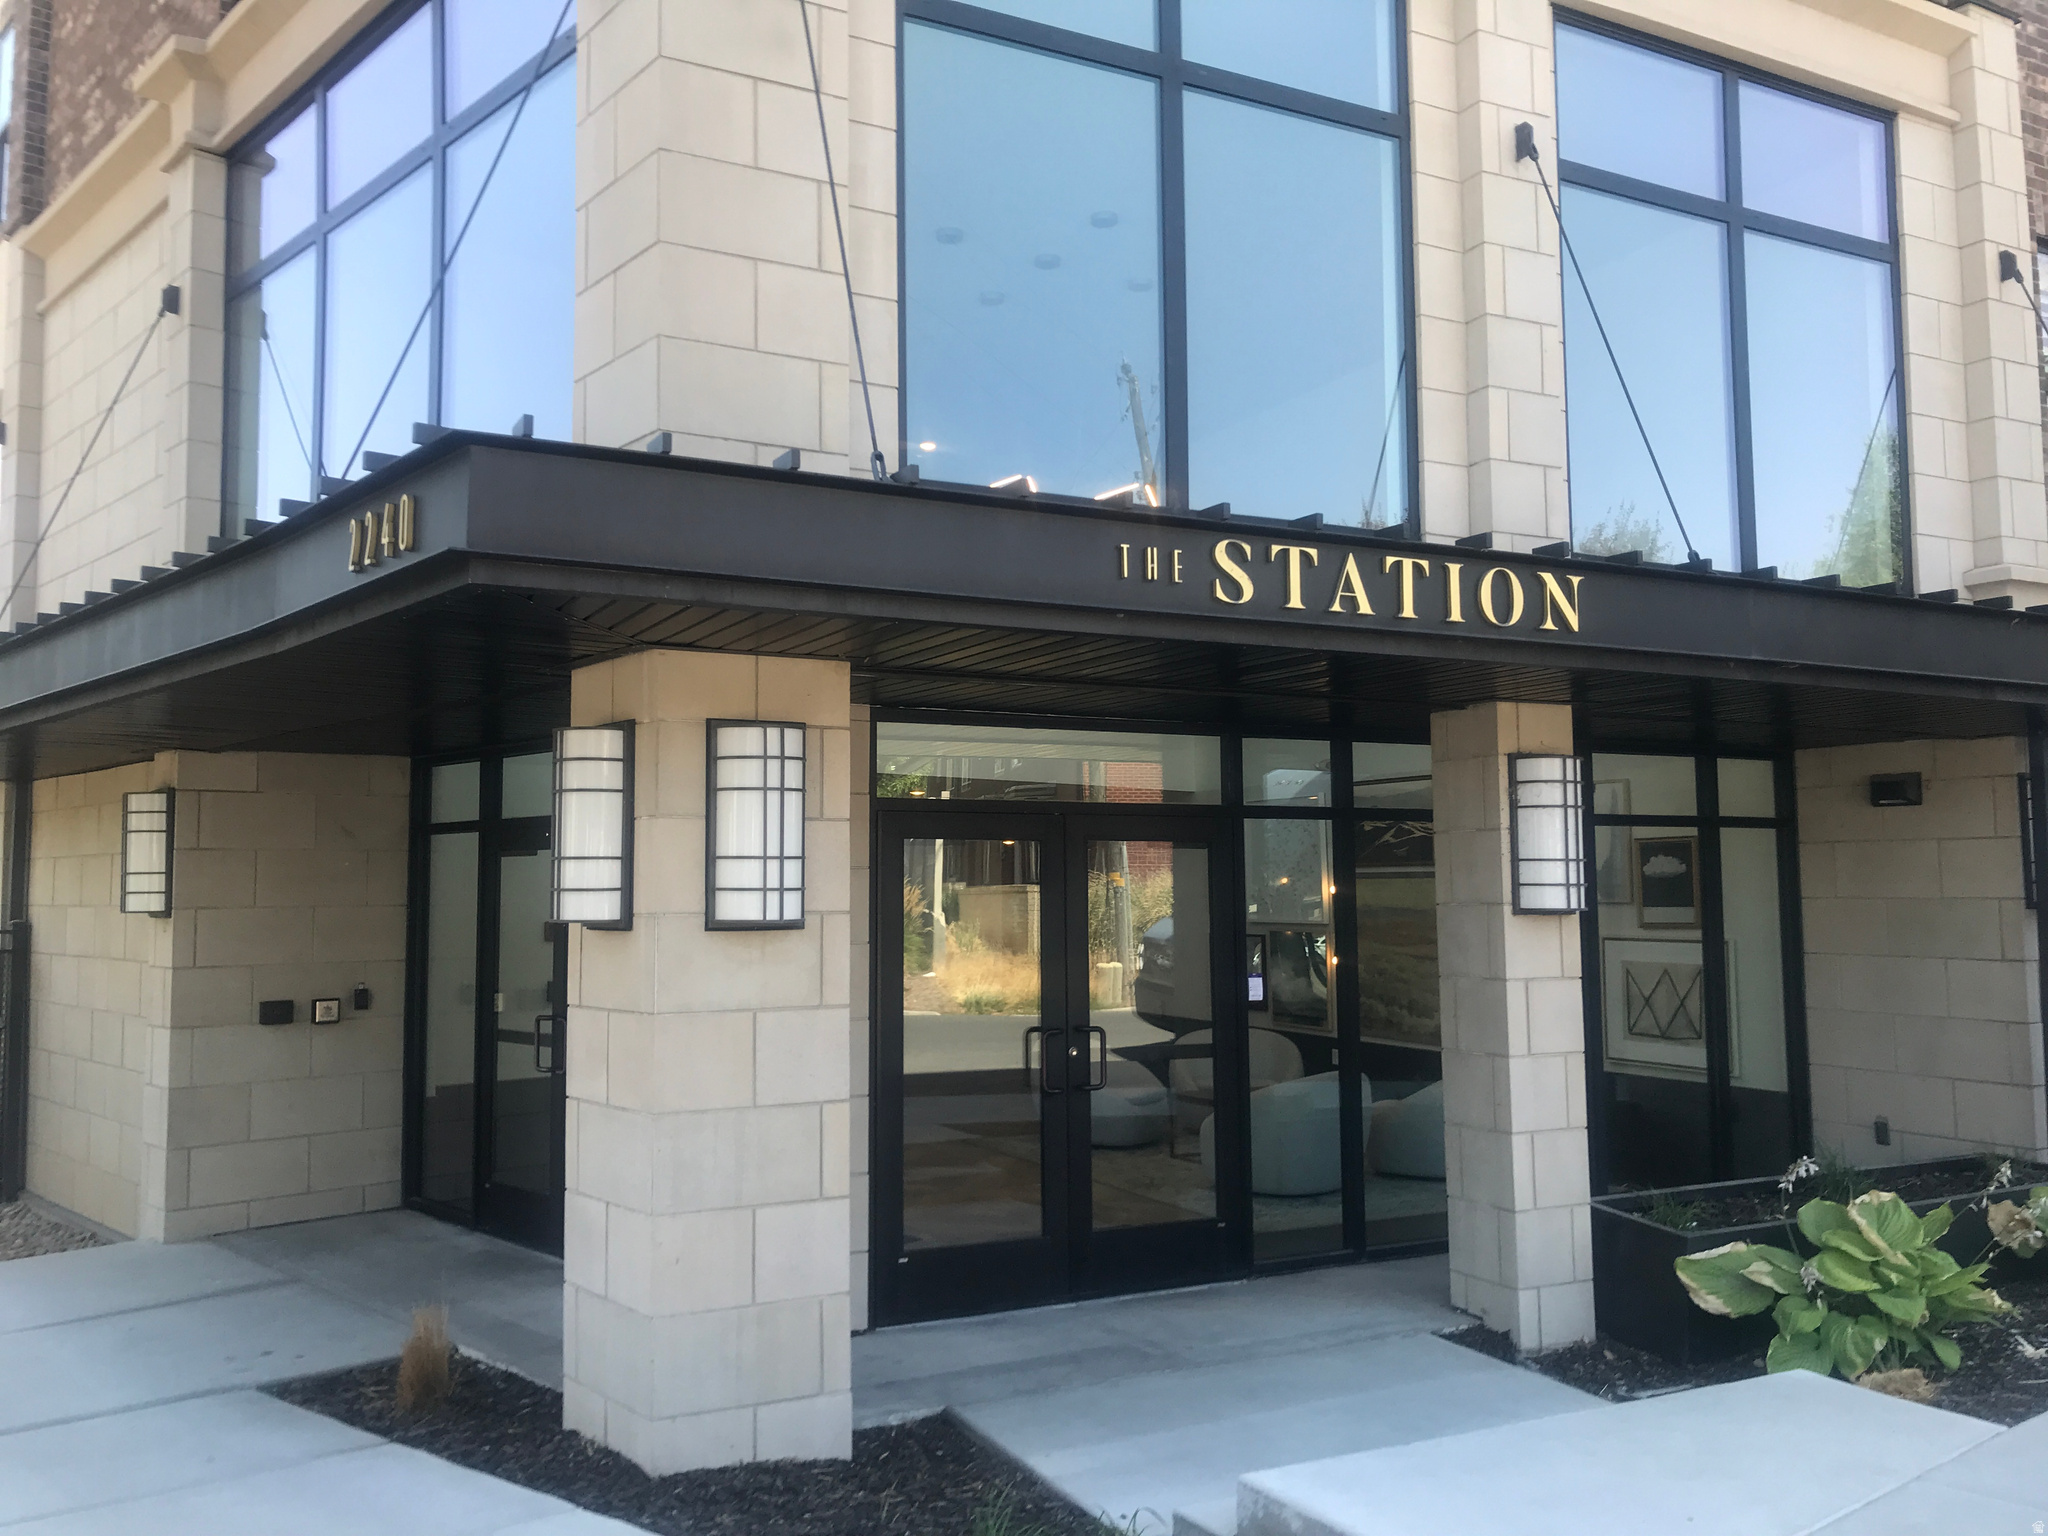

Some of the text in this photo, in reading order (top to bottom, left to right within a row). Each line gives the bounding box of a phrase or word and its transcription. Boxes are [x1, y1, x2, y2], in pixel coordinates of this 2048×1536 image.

[348, 493, 414, 572] 2240
[1117, 538, 1585, 633] THE STATION
